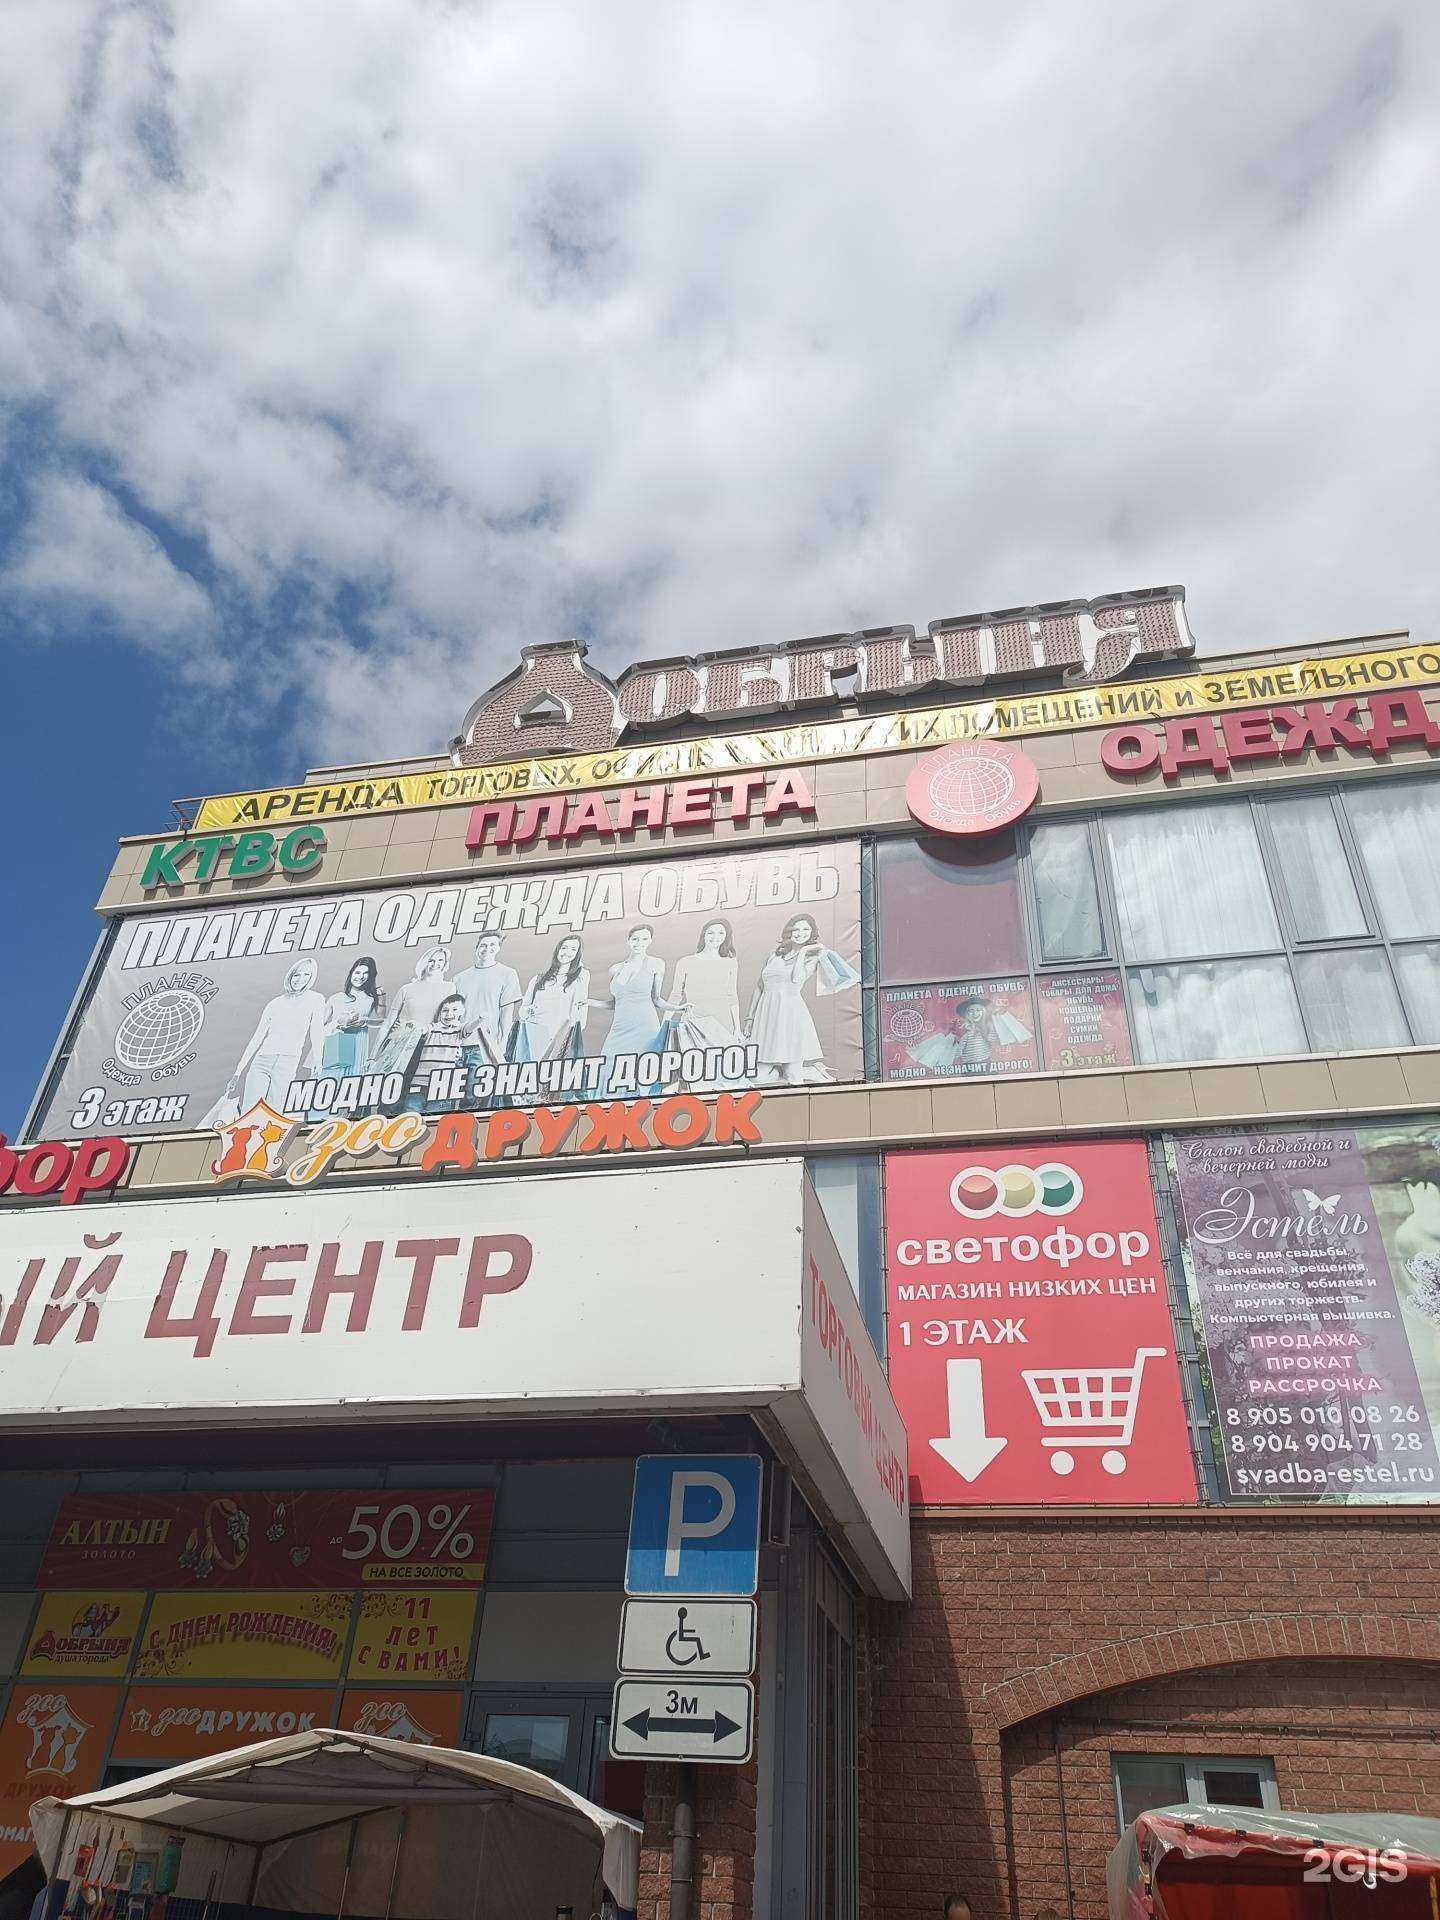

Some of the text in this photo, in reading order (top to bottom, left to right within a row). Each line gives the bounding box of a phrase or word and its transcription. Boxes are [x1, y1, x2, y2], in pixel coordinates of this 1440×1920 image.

[232, 781, 404, 823] АРЕНДА
[1204, 652, 1440, 703] ЗЕМЕЛЬНОГО
[920, 745, 1015, 776] ПЛАНЕТА
[465, 769, 818, 849] ПЛАНЕТА
[985, 799, 1021, 823] Обувь
[139, 825, 325, 890] КТВС
[121, 851, 840, 970] ПЛАНЕТА ОДЕЖДА ОБУВЬ
[121, 972, 220, 1010] ПЛАНЕТА
[886, 982, 1025, 1002] ПЛАНЕТА ОДЕЖДА ОБУВЬ
[1052, 976, 1104, 987] АКСЕССУАРЫ
[1059, 1004, 1104, 1015] КОШЕЛЬКИ
[1067, 996, 1093, 1004] ОБУВЬ
[1064, 1014, 1102, 1024] ПОДАРКИ
[1070, 1024, 1098, 1034] СУМКИ
[1068, 1034, 1103, 1044] ОДЕЖДА
[102, 1052, 197, 1086] Одежда Обувь
[1060, 1049, 1116, 1067] 3 этаж
[284, 1071, 404, 1113] МОДНО
[428, 1066, 468, 1100] НЕ
[474, 1056, 605, 1097] ЗНАЧИТ
[608, 1044, 760, 1092] ДОРОГО!
[890, 1067, 926, 1079] МОДНО
[947, 1062, 988, 1075] ЗНАЧИТ
[989, 1060, 1033, 1072] ДОРОГО!
[70, 1086, 189, 1129] 3 этаж
[1181, 1136, 1350, 1158] Салон свадебной и
[1203, 1153, 1328, 1178] вечерней моды
[1192, 1186, 1369, 1244] Эстель
[896, 1225, 1150, 1268] светофор
[1227, 1247, 1350, 1261] Всё для свадьбы,
[1216, 1263, 1369, 1276] венчания, крещения,
[143, 1233, 533, 1358] ЦЕНТР
[897, 1277, 1156, 1300] МАГАЗИН НИЗКИХ ЦЕН
[1214, 1277, 1377, 1293] выпускного, юбилея и
[1234, 1293, 1363, 1309] других торжеств.
[1210, 1309, 1395, 1325] Компьютерная вышивка.
[899, 1318, 1029, 1346] 1 ЭТАЖ
[1250, 1333, 1362, 1350] ПРОДАЖА
[1266, 1355, 1353, 1370] ПРОКАТ
[1248, 1377, 1383, 1393] РАССРОЧКА
[1226, 1405, 1420, 1425] 8 905 010 08 26
[1231, 1432, 1423, 1453] 8 904 904 71 28
[1236, 1461, 1434, 1484] svadba-estel.ru
[60, 1518, 172, 1545] АЛТЫН
[341, 1503, 474, 1561] 50%
[664, 1471, 736, 1577] P
[369, 1566, 464, 1578] НА ВСЕ ЗОЛОТО
[404, 1598, 432, 1619] 11
[168, 1613, 221, 1646] ДНЕМ
[226, 1611, 338, 1651] РОЖДЕНИЯ!
[377, 1646, 461, 1671] ВАМИ!
